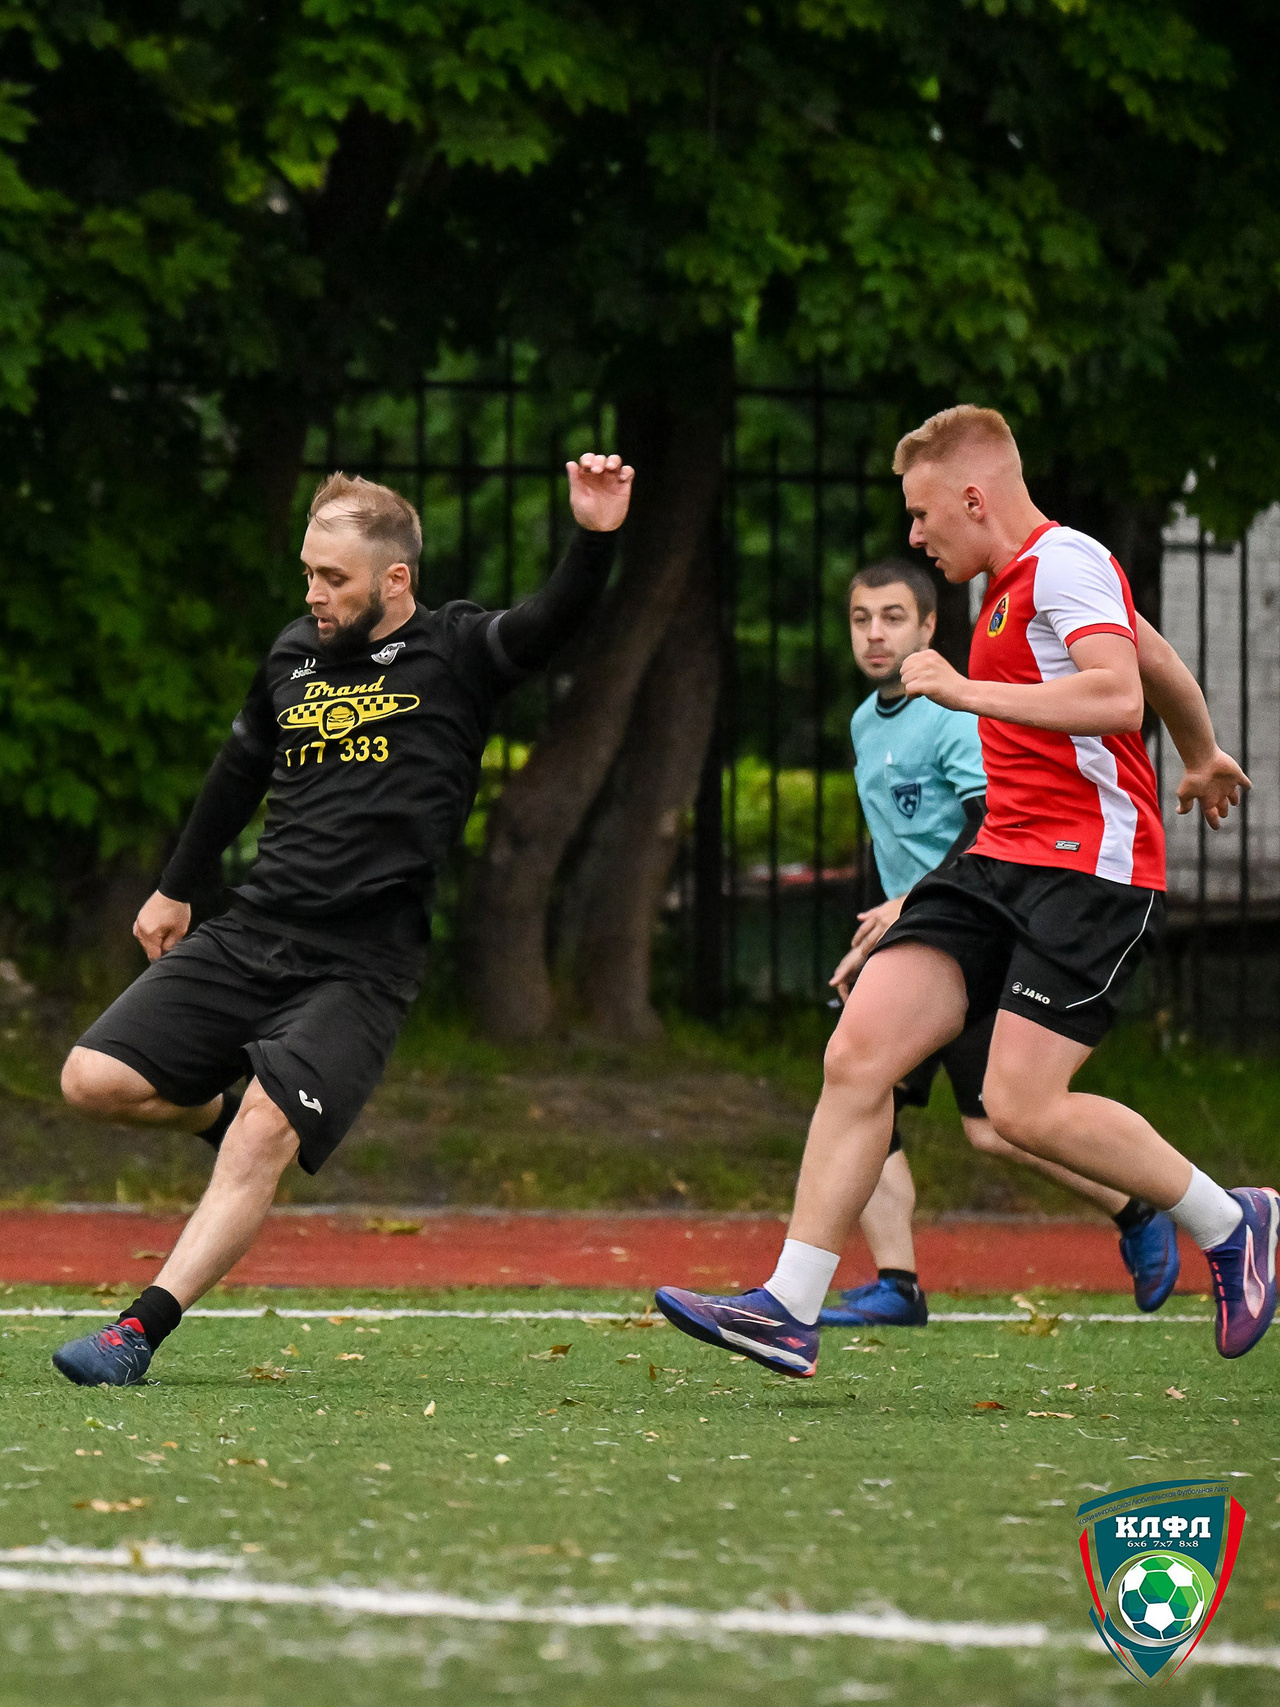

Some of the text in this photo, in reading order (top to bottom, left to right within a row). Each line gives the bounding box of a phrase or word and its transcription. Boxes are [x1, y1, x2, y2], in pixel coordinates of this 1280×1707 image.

[304, 675, 385, 700] Brand
[339, 736, 389, 762] 333
[1022, 988, 1050, 1004] JAKO
